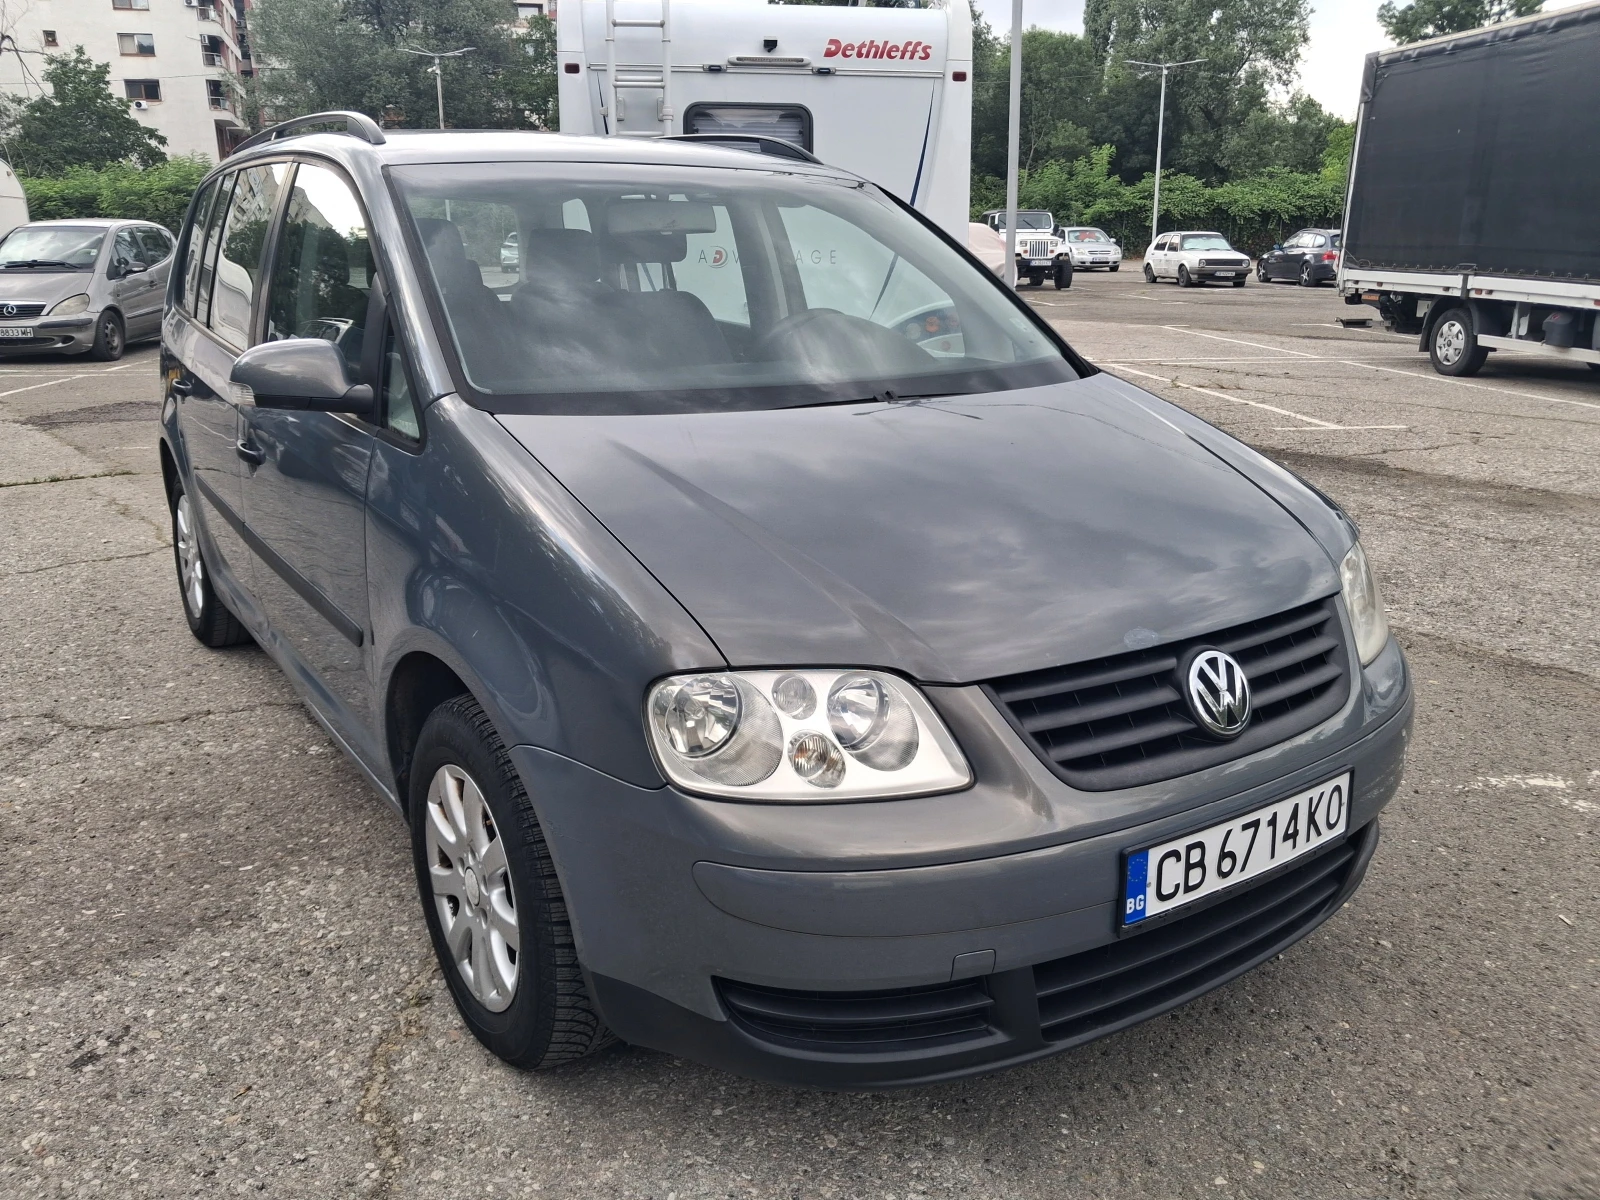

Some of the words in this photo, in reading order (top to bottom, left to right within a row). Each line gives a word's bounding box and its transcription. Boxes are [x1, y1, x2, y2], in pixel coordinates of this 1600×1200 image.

[823, 38, 932, 61] Dethleffs
[698, 247, 837, 267] ADVAGE
[20, 328, 32, 336] MH
[1154, 840, 1207, 902] CB
[1216, 802, 1300, 879] 6714
[1125, 893, 1145, 915] BG
